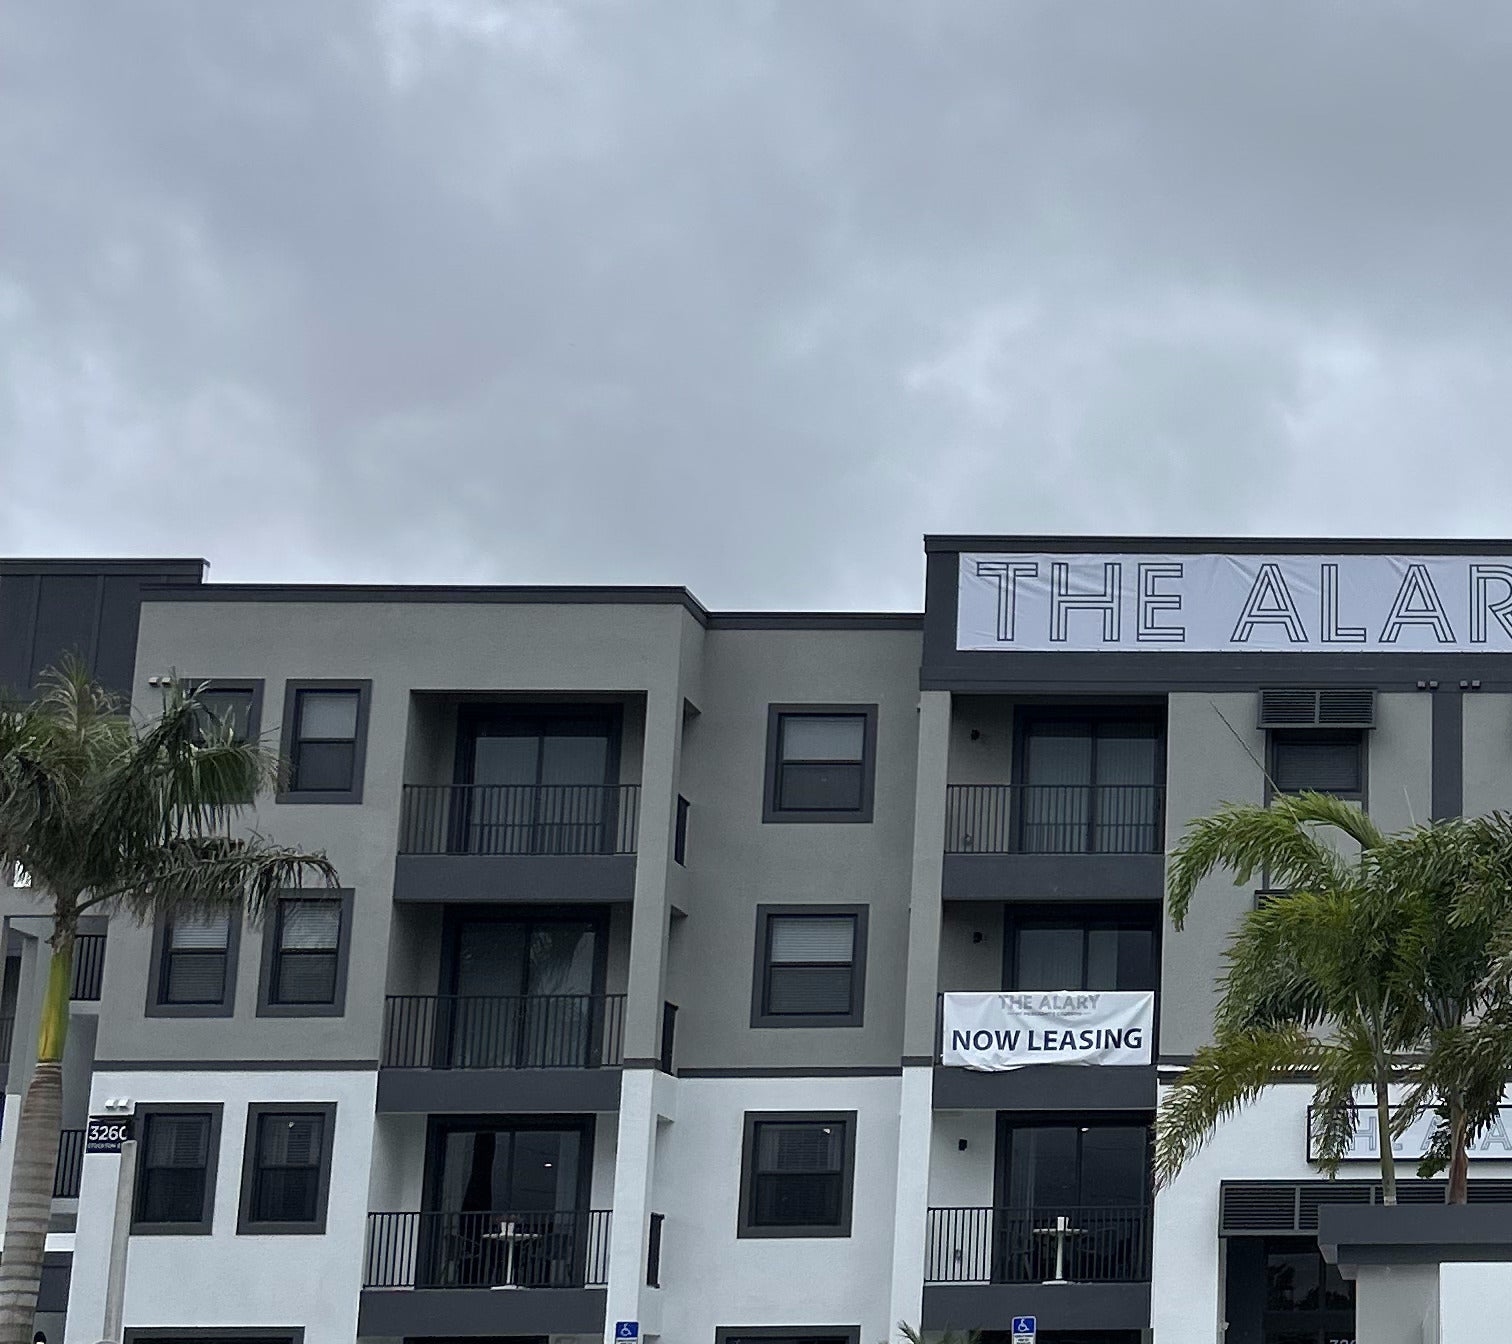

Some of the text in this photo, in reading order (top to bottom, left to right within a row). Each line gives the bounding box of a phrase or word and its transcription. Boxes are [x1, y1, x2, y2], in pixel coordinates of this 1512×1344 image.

[976, 561, 1186, 642] THE
[998, 994, 1101, 1010] THE ALARY
[952, 1027, 1143, 1052] NOW LEASING
